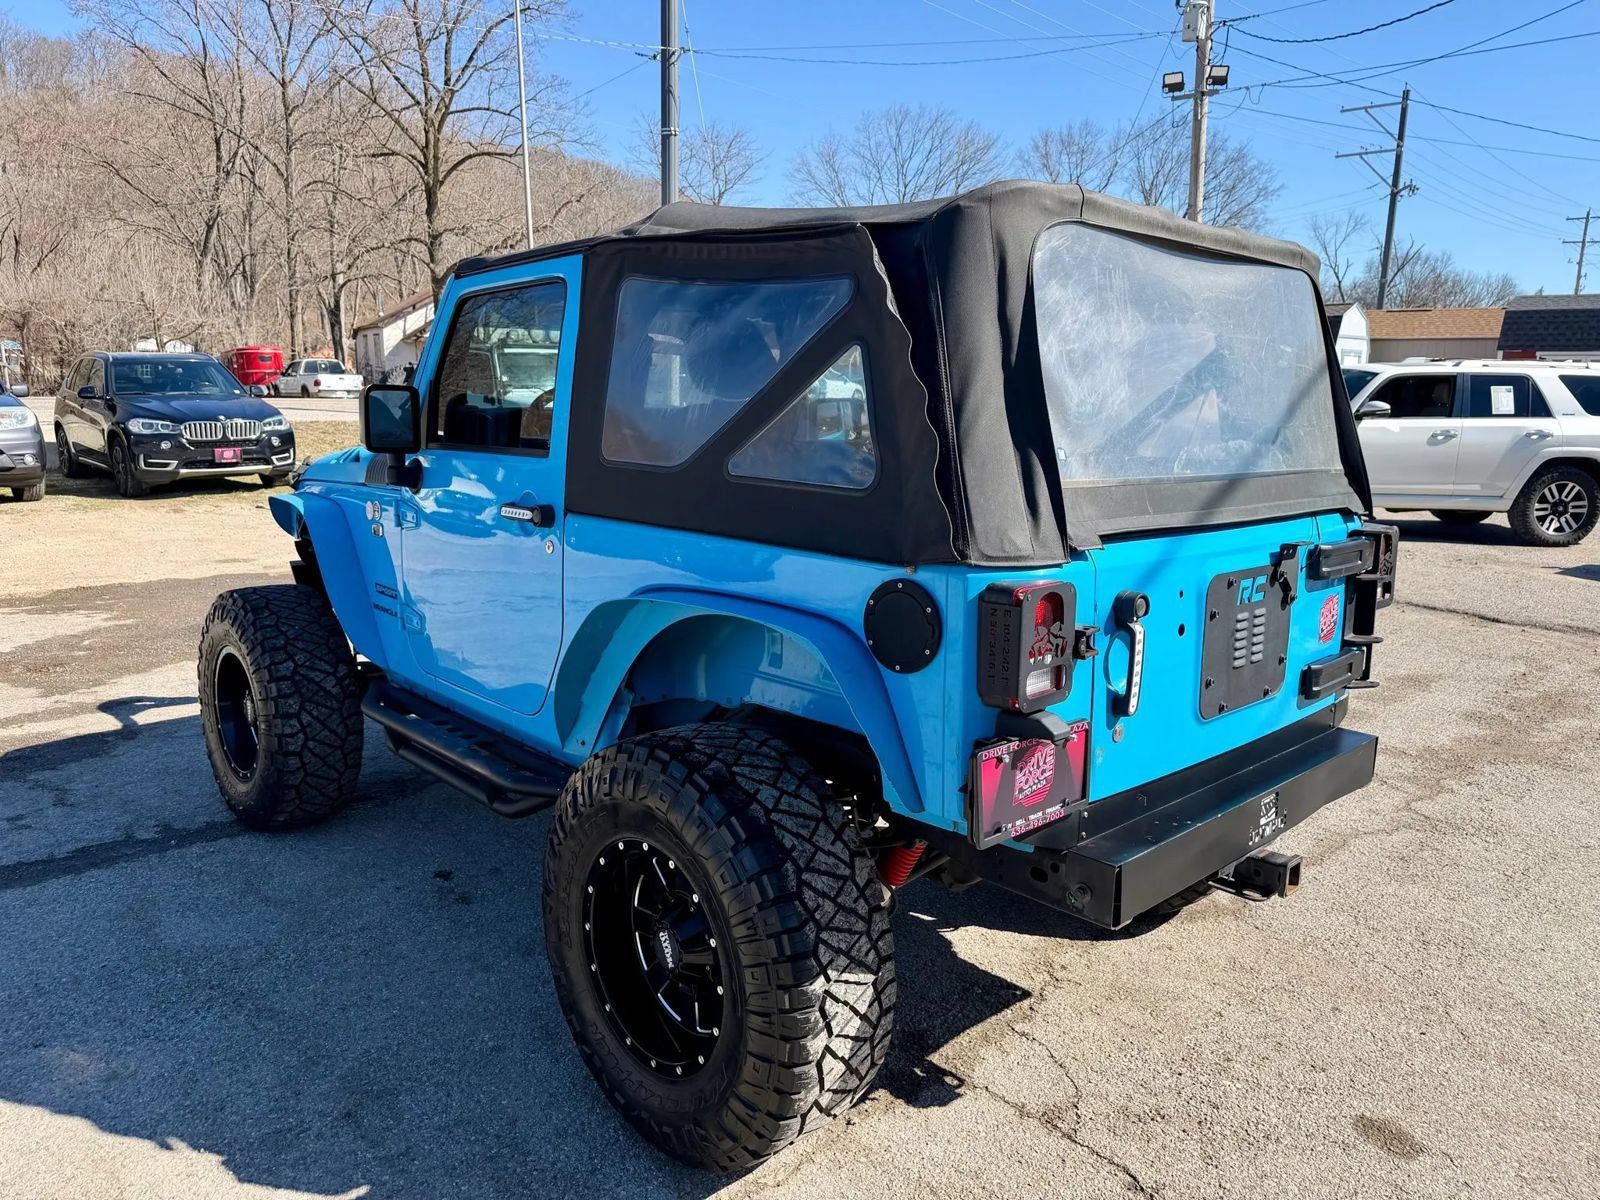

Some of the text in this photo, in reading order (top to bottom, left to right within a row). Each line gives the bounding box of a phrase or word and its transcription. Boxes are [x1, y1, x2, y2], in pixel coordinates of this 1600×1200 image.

[1237, 575, 1268, 606] RC
[982, 745, 1008, 760] DRIVE
[1010, 738, 1038, 752] FORCE
[1016, 744, 1055, 779] DRIVE
[1015, 760, 1054, 794] FORCE
[1018, 779, 1047, 800] AUTO PLAZA
[1011, 809, 1065, 837] 636-496-7003
